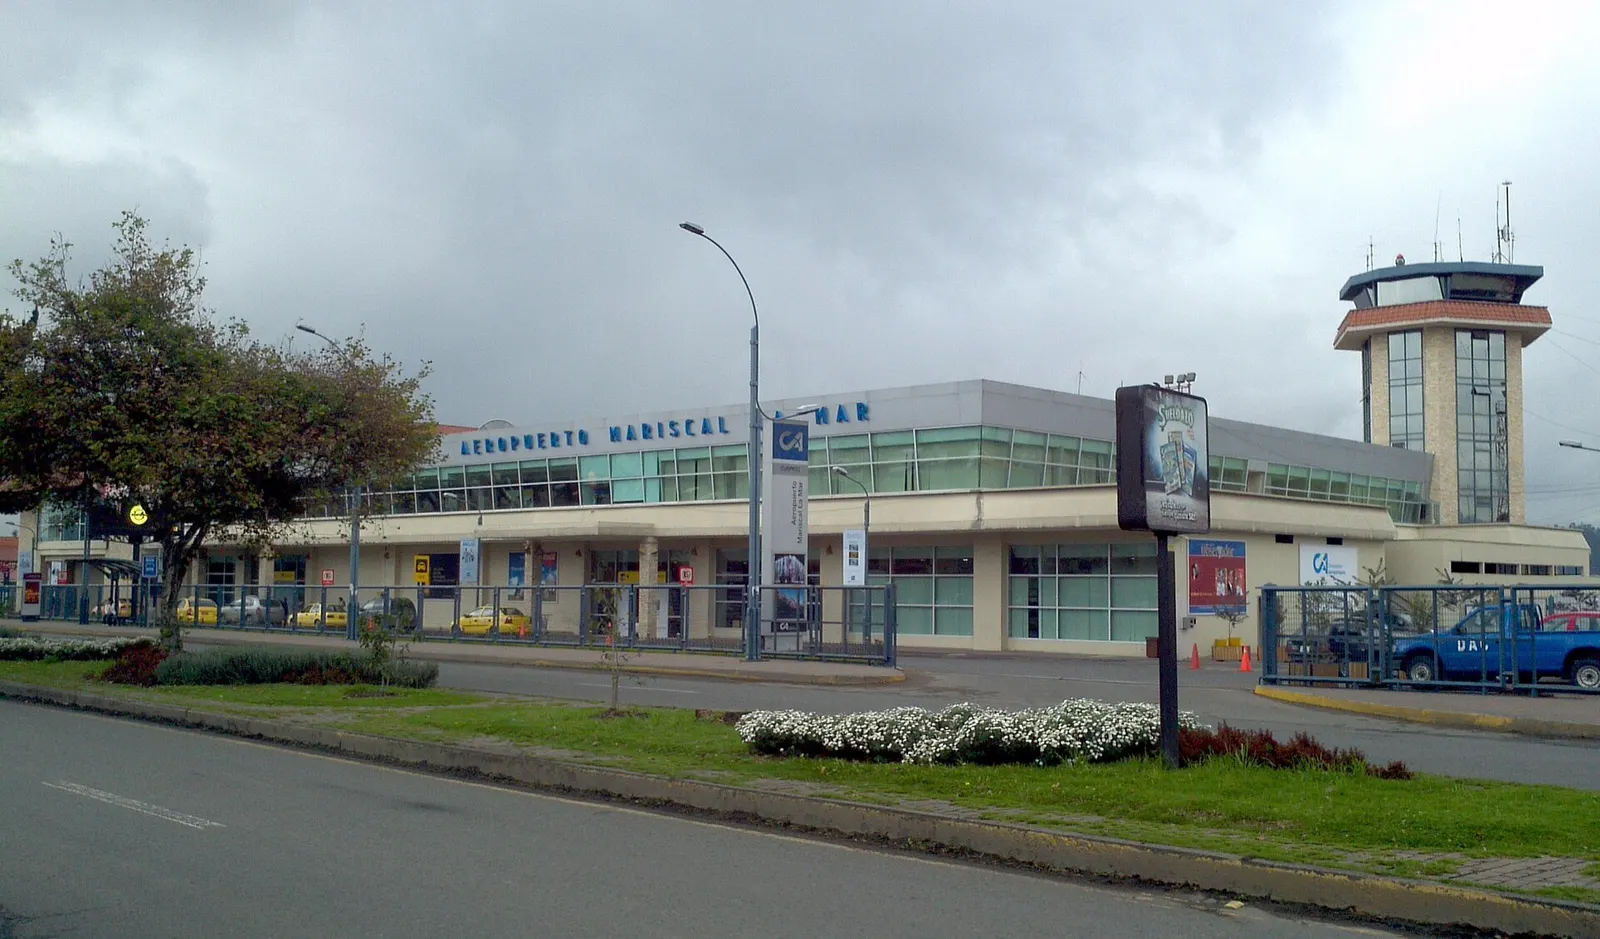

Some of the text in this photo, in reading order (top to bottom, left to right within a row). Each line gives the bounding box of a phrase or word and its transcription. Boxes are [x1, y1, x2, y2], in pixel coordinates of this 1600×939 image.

[460, 428, 590, 456] AEROPUERTO
[608, 416, 730, 442] MARISCAL
[815, 402, 870, 425] MAR
[797, 499, 804, 509] La
